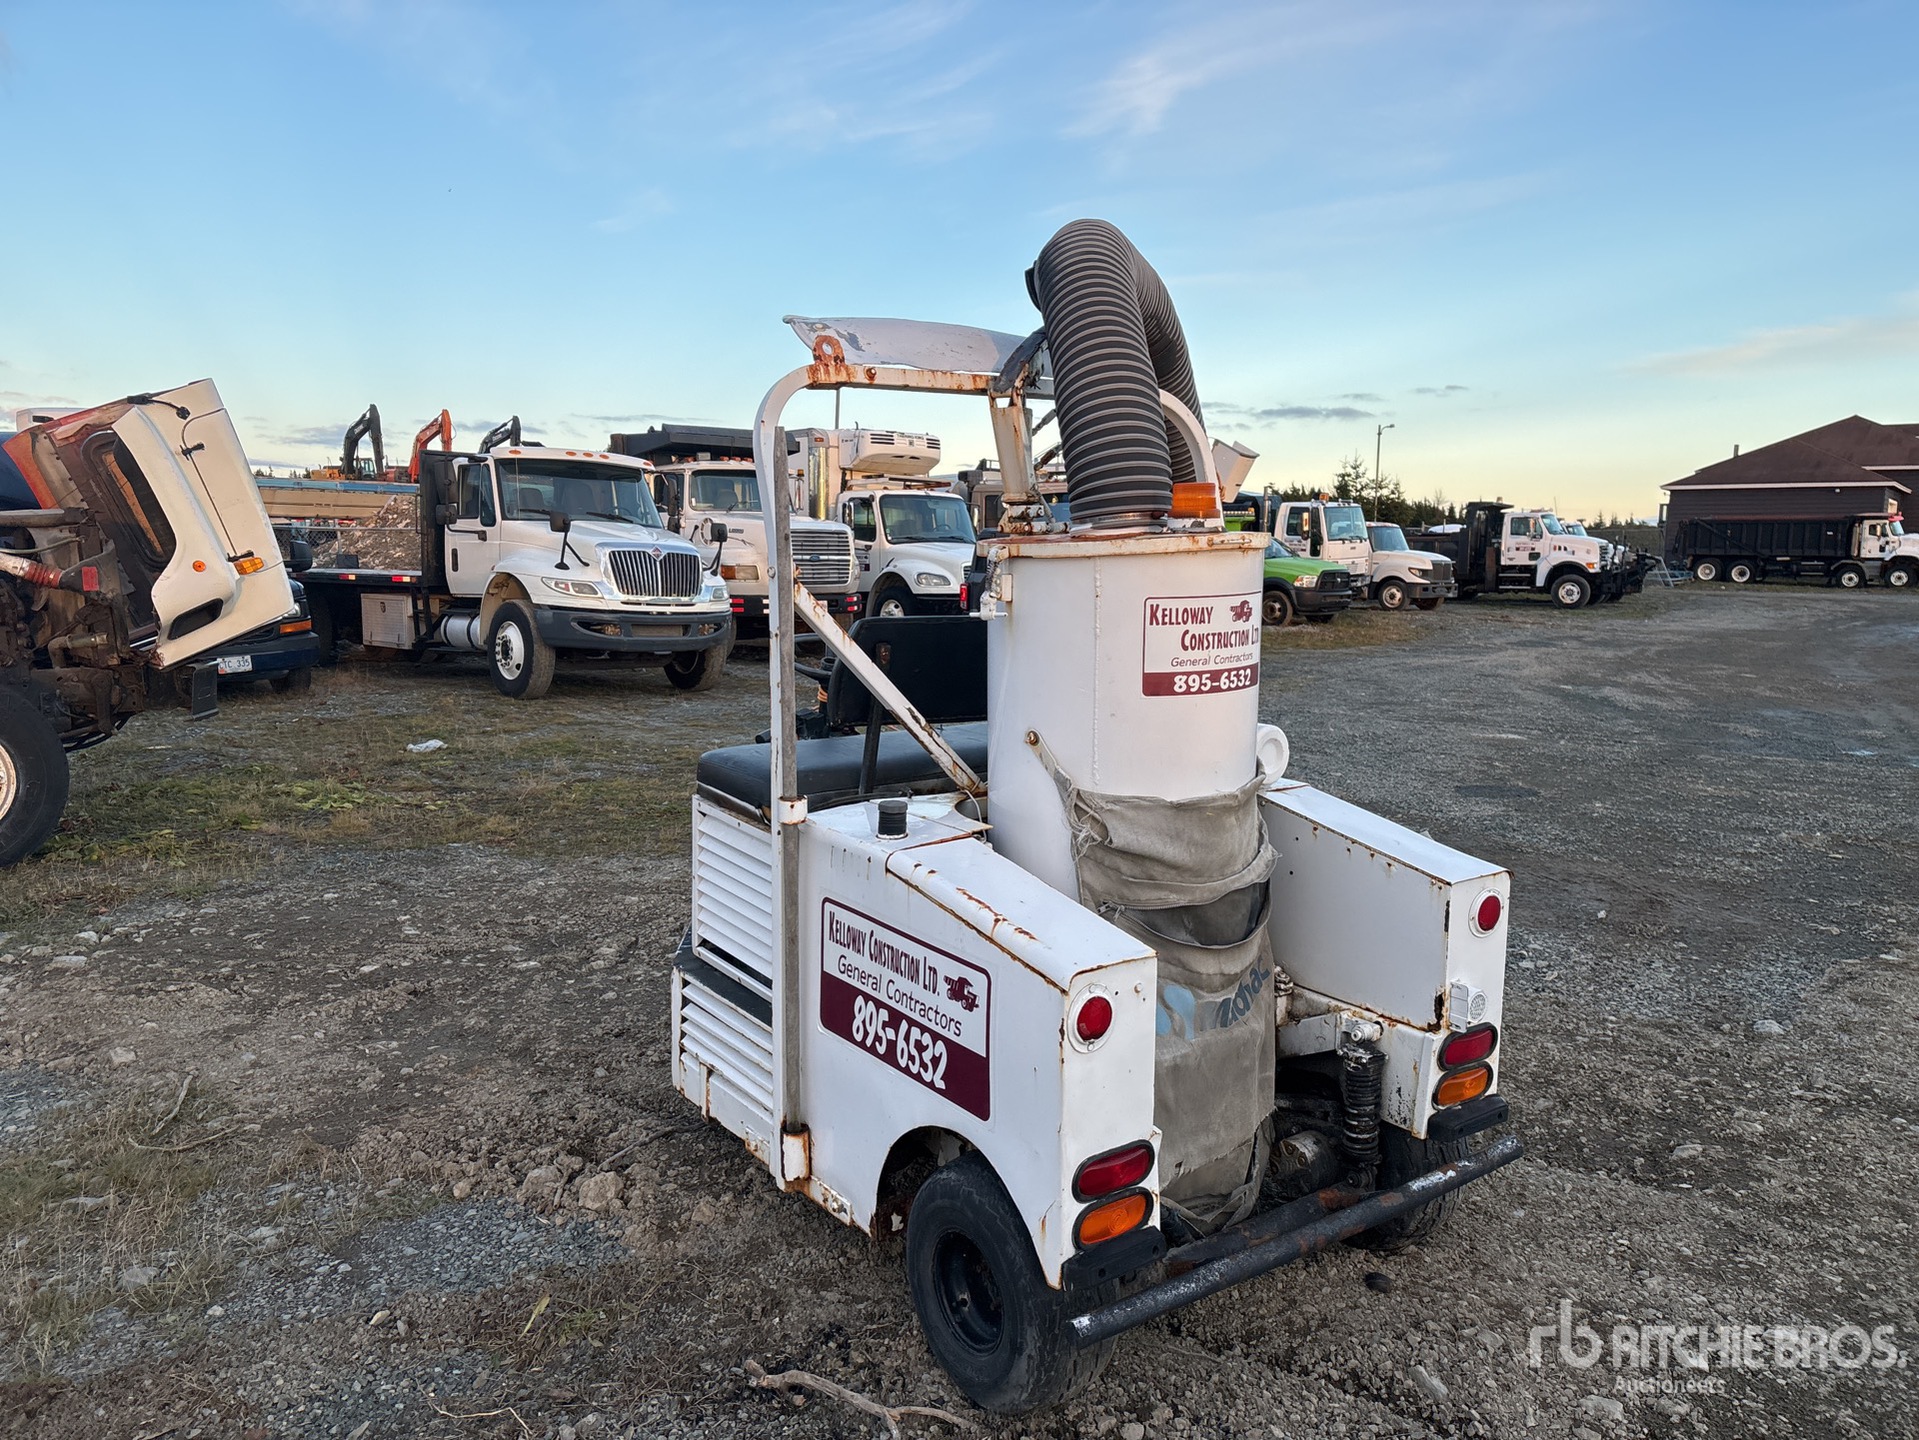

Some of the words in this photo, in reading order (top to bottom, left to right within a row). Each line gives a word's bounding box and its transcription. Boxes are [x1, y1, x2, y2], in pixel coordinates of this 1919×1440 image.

[1149, 603, 1214, 626] KELLOWAY
[1180, 629, 1250, 652] CONSTRUCTION
[236, 658, 250, 668] 335
[1171, 655, 1211, 668] General
[1213, 651, 1253, 665] Contractors
[1173, 668, 1251, 693] 895-6532
[828, 911, 866, 957] KELLOWAY
[869, 929, 920, 984] CONSTRUCTION
[923, 955, 941, 996] LTD.
[837, 954, 882, 994] General
[885, 980, 962, 1038] Contractors
[851, 995, 947, 1090] 895-6532
